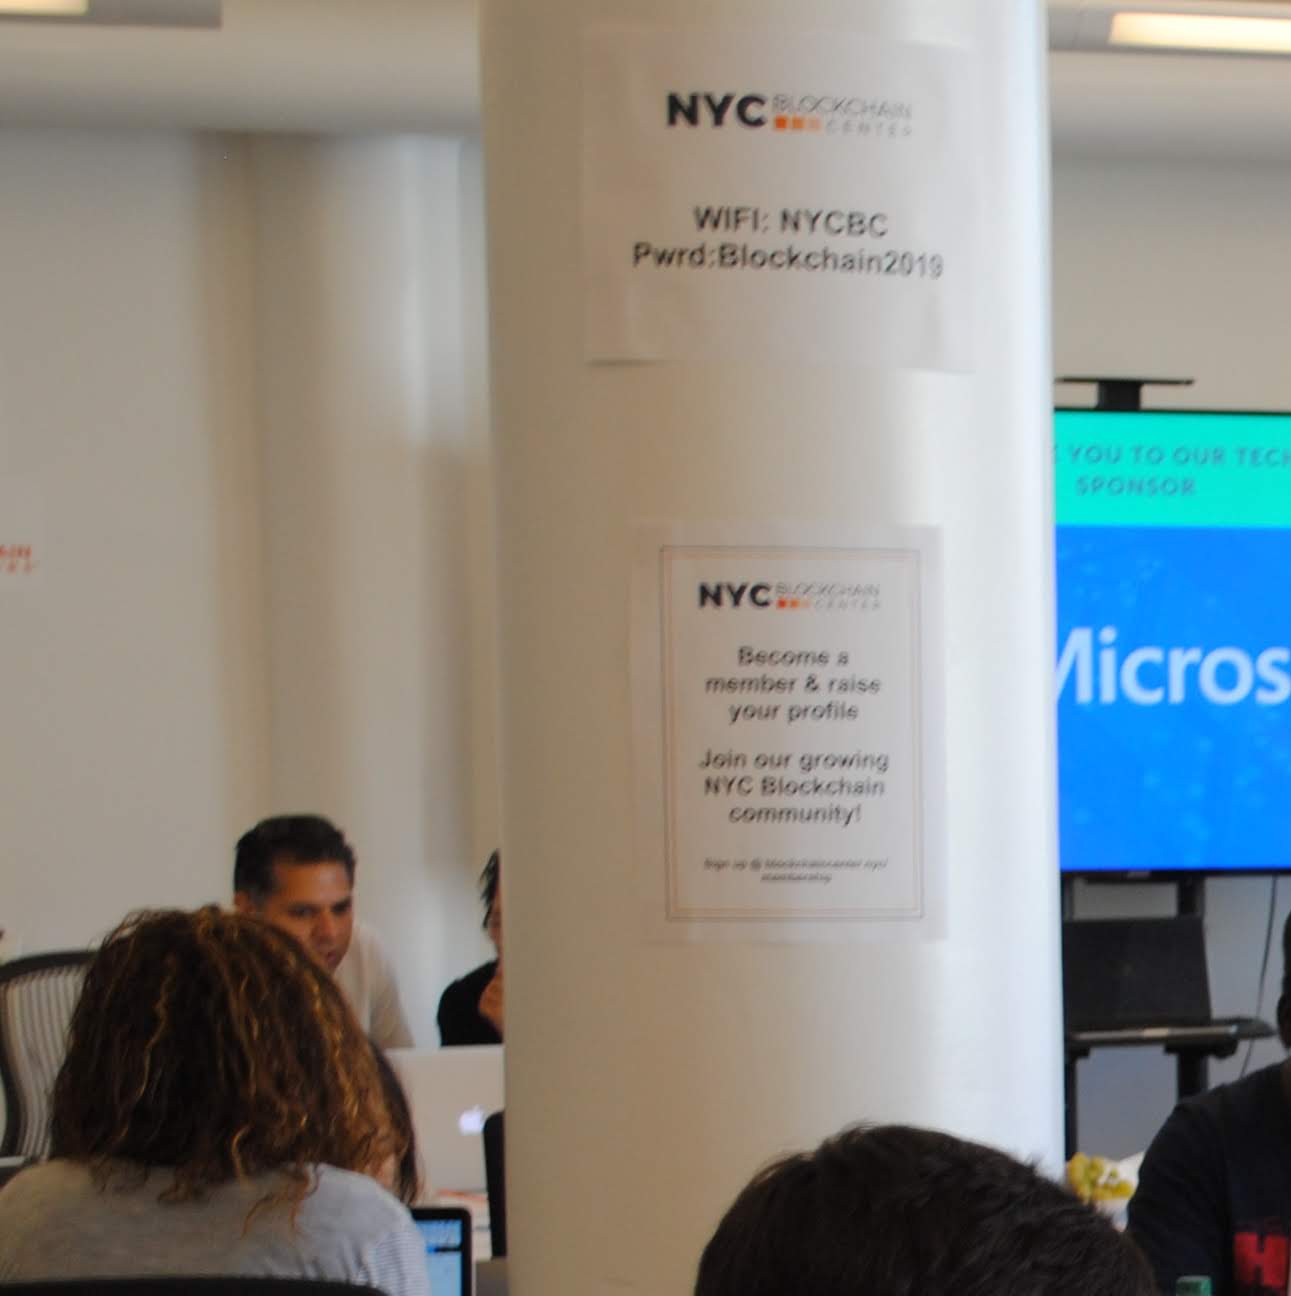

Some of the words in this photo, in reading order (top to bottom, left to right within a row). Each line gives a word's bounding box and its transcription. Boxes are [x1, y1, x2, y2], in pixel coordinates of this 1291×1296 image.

[666, 92, 768, 129] NYC
[772, 94, 912, 119] BLOCKCHAIN
[826, 119, 913, 137] CENTER
[693, 205, 769, 233] WIFI:
[780, 208, 888, 238] NYCBC
[632, 242, 944, 280] Pwrd:Blockchain2019
[1070, 445, 1122, 466] YOU
[1132, 446, 1164, 466] TO
[1173, 447, 1227, 467] OUR
[1075, 475, 1197, 498] SPONSOR
[698, 582, 771, 608] NYC
[775, 582, 880, 597] BLOCKCHAIN
[737, 646, 830, 667] Become
[837, 651, 849, 667] a
[705, 674, 796, 694] member
[804, 675, 819, 693] &
[827, 677, 882, 694] raise
[728, 706, 779, 726] your
[787, 701, 859, 724] profile
[699, 749, 748, 770] Join
[753, 754, 792, 770] our
[799, 751, 889, 774] growing
[704, 776, 752, 796] NYC
[761, 776, 886, 797] Blockchain
[727, 803, 862, 826] community!
